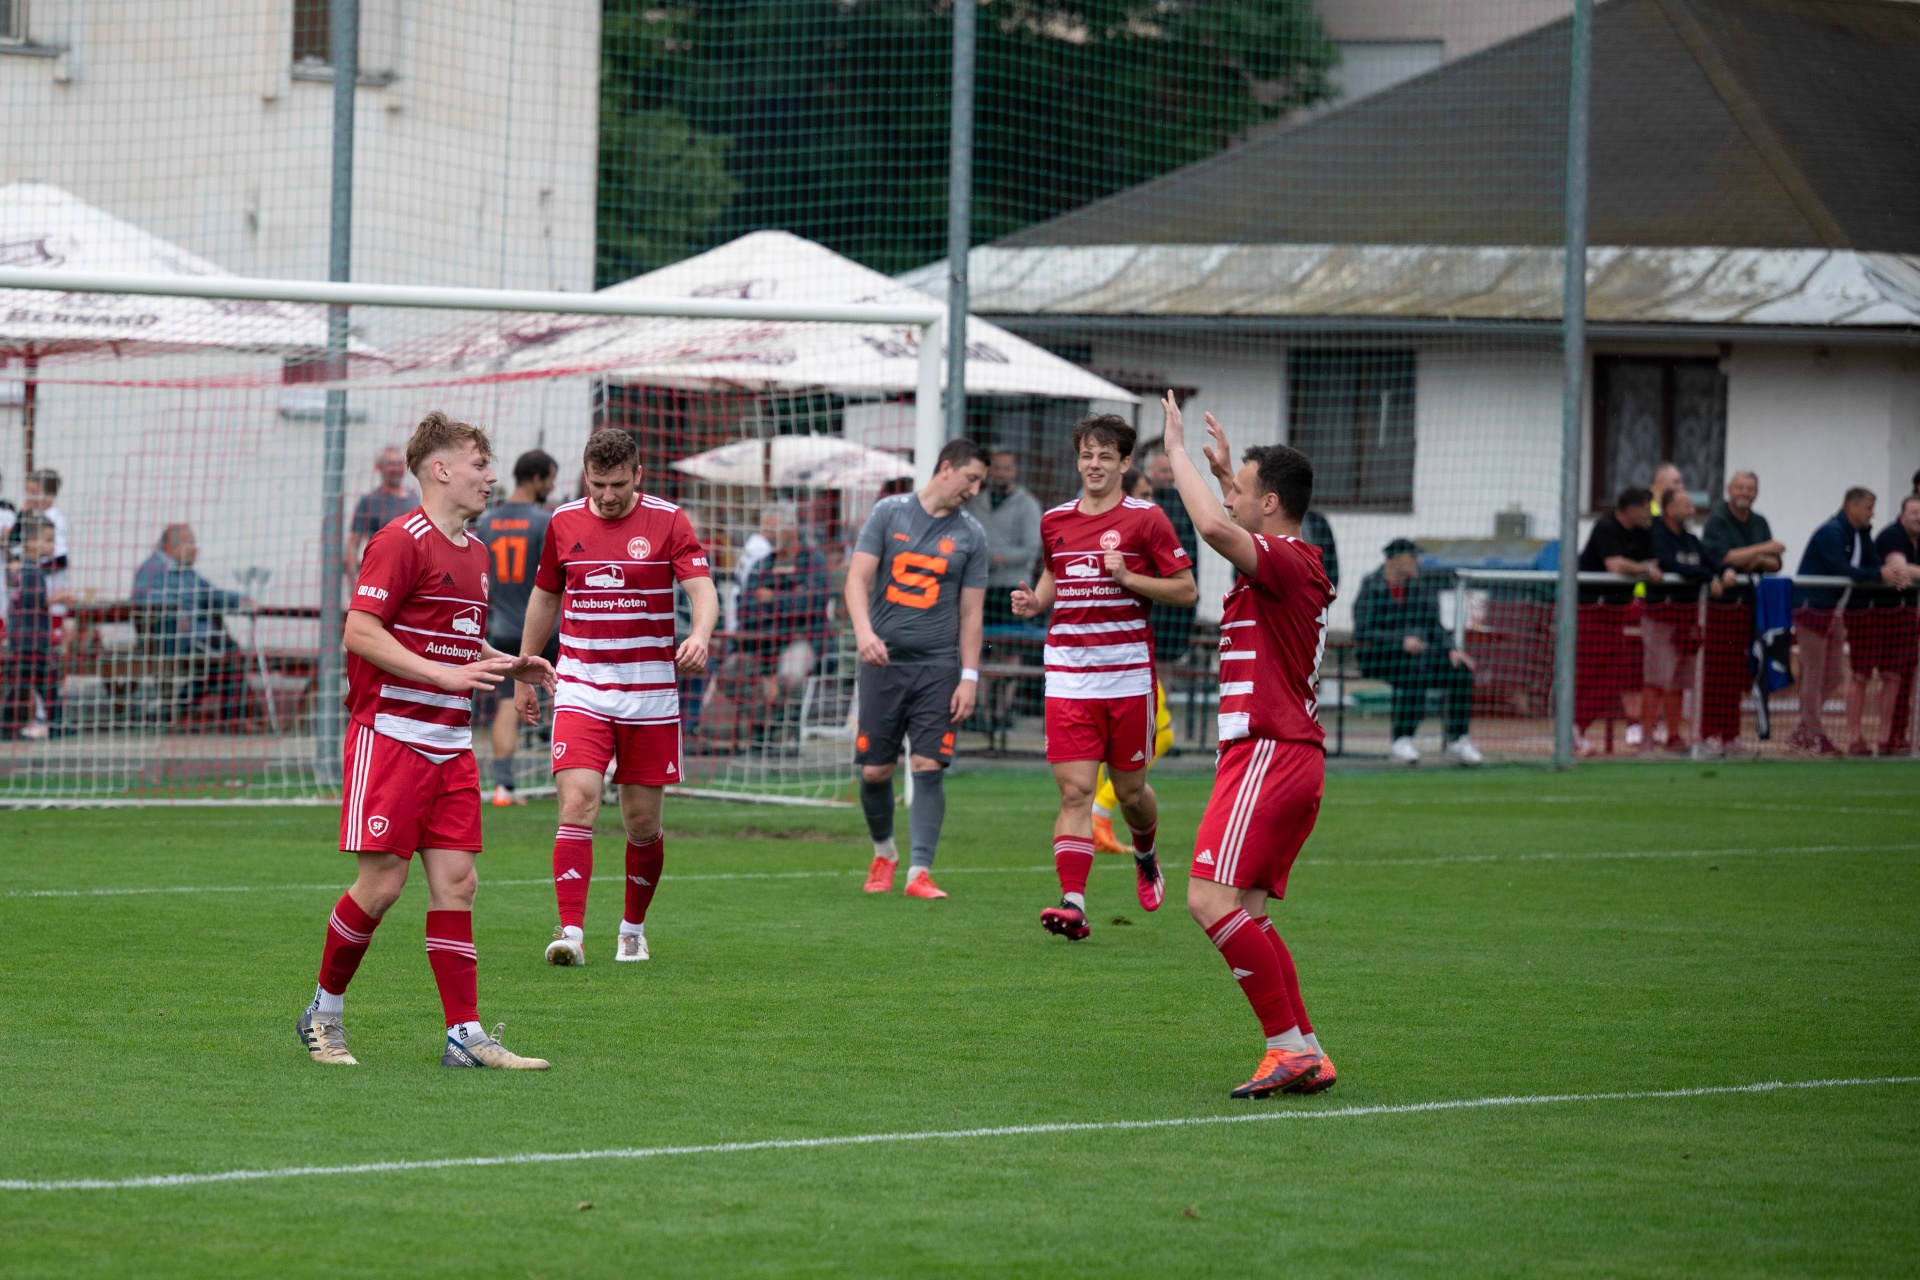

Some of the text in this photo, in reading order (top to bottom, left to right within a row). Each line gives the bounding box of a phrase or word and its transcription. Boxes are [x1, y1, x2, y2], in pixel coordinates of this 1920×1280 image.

[489, 536, 528, 584] 17
[885, 551, 949, 609] S
[571, 598, 647, 611] Autobusy-Koten
